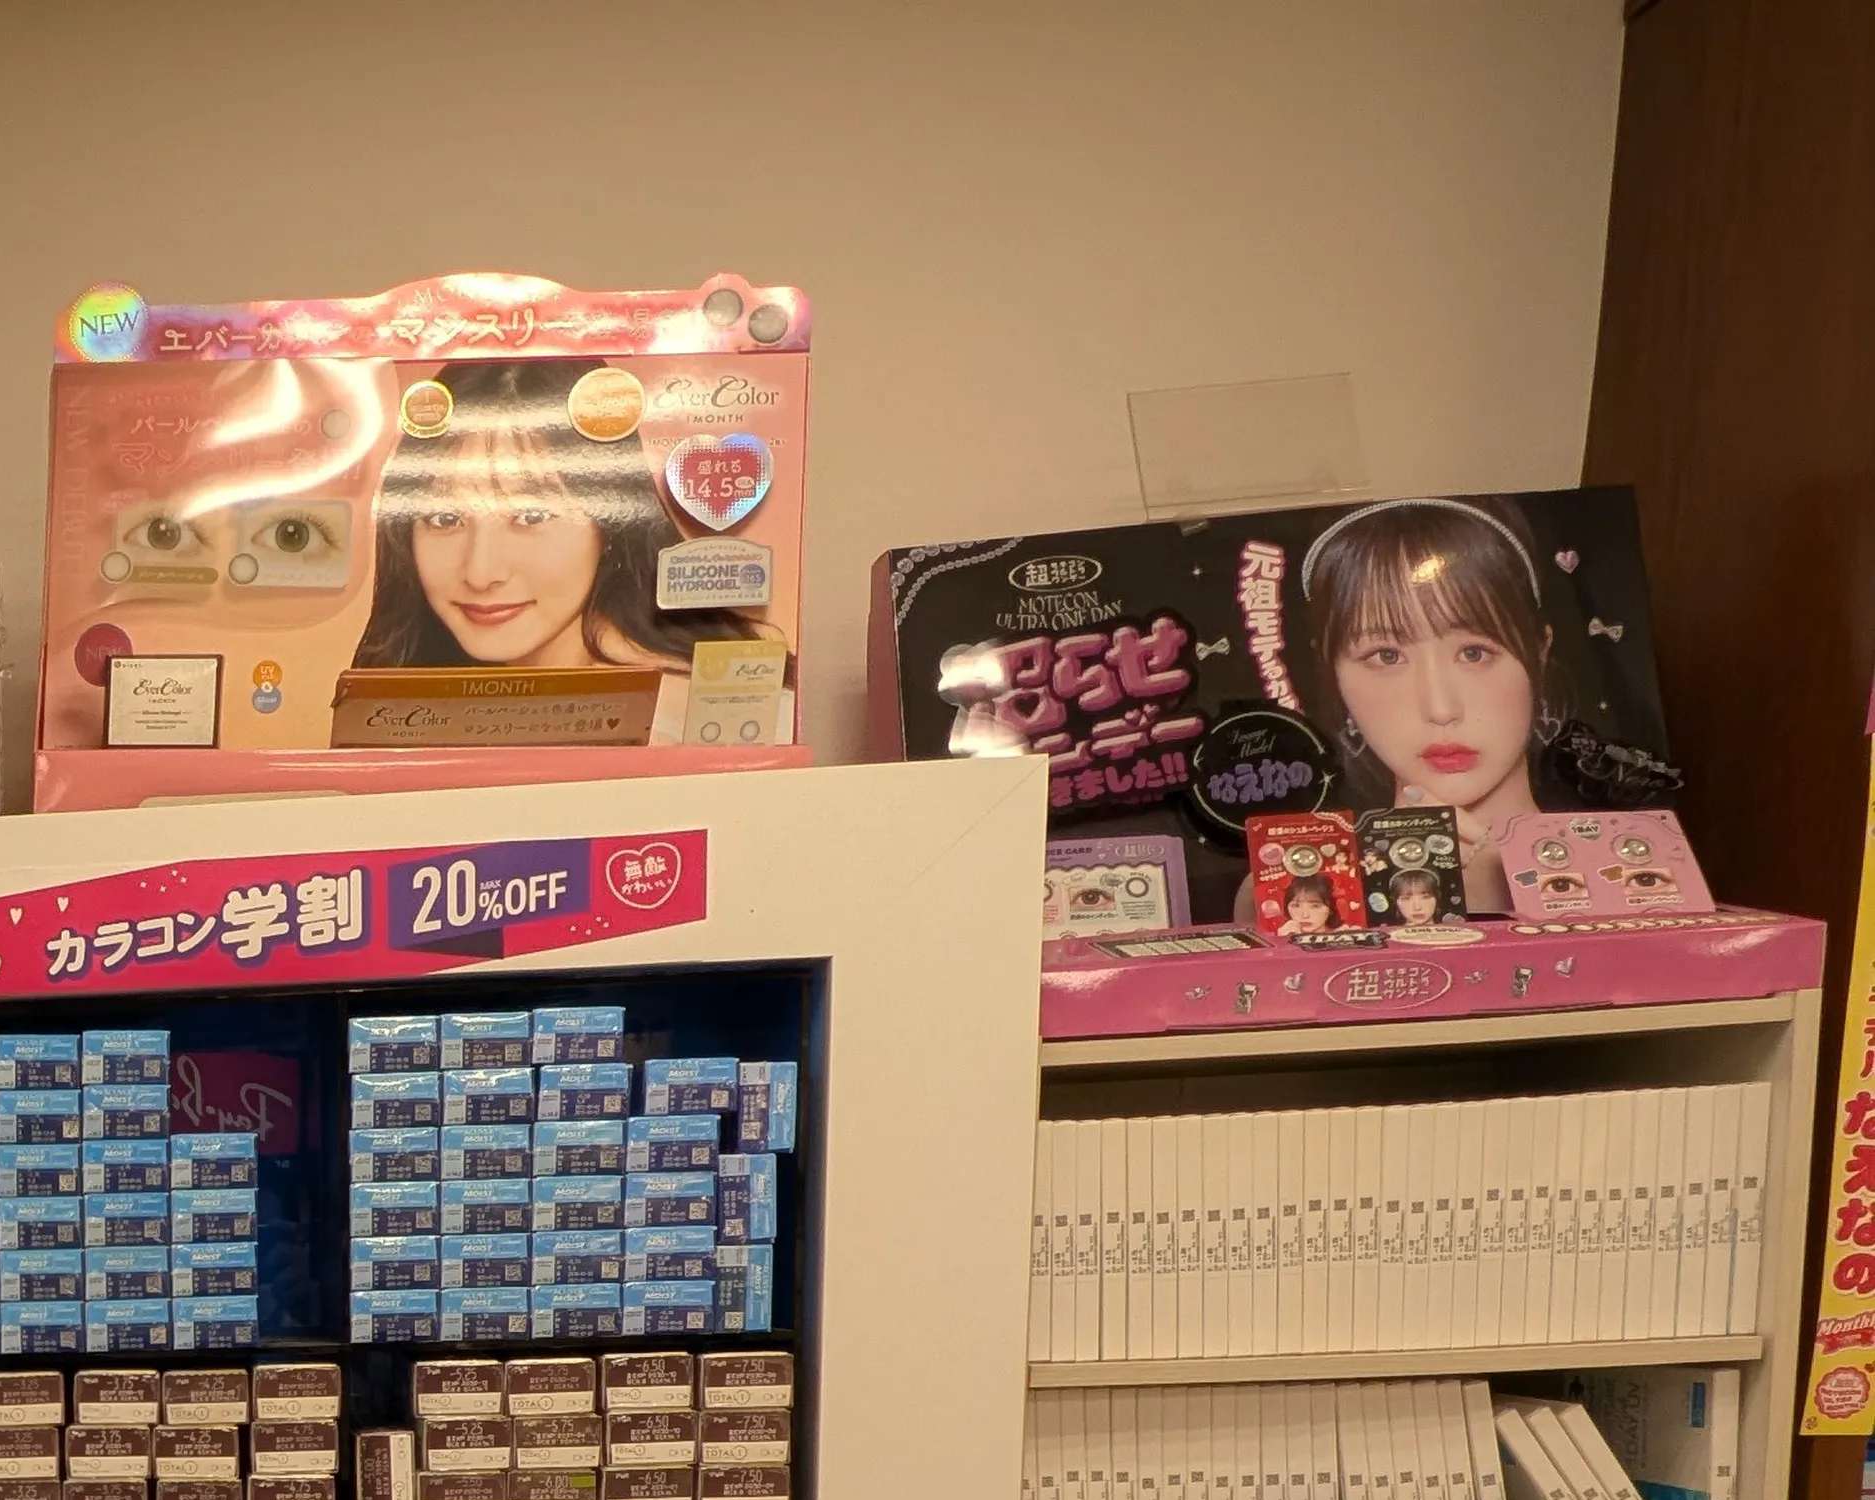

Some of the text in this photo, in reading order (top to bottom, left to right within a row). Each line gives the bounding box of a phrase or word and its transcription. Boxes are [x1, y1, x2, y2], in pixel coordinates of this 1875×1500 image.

[79, 311, 140, 338] NEW
[697, 459, 742, 473] 盛れる
[686, 478, 734, 498] 14.5
[667, 564, 740, 580] SILICONE
[667, 580, 741, 593] HYDROGEL
[1019, 591, 1098, 615] MOTECON
[995, 600, 1123, 632] ULTRA ONE DAY
[133, 677, 193, 696] EverColor
[461, 679, 535, 696] 1MONTH
[365, 704, 452, 728] EverColor
[46, 866, 366, 977] カラコン学割
[1346, 968, 1383, 1002] 超
